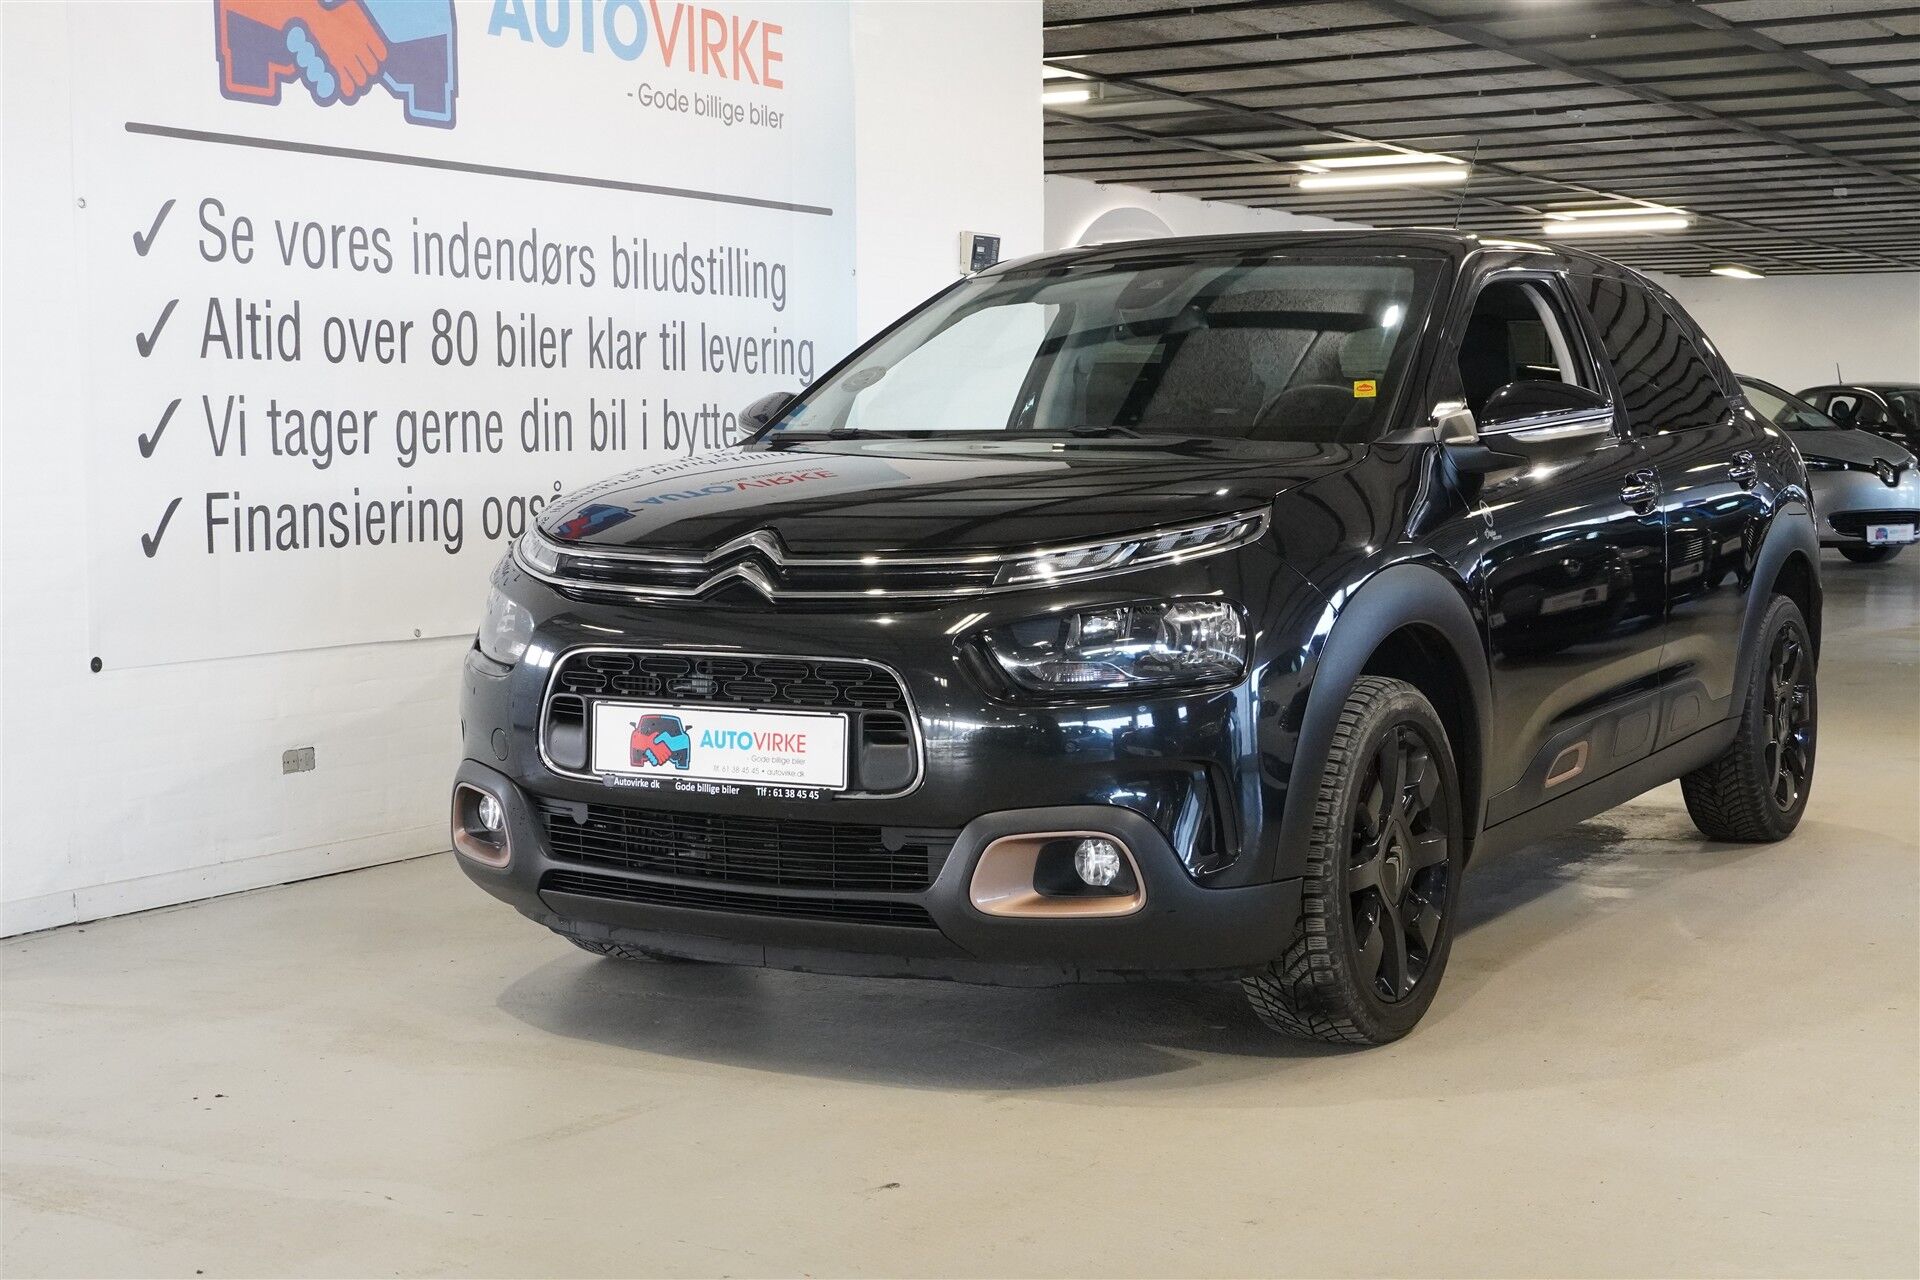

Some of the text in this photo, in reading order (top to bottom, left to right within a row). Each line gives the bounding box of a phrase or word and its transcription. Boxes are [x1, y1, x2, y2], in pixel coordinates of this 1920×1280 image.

[638, 83, 689, 113] Gode
[694, 92, 744, 126] billige
[749, 102, 784, 129] biler
[199, 197, 787, 312] Se vores indendørs biludstilling
[200, 297, 814, 387] Altid over 80 biler klar til levering
[202, 394, 738, 470] Vi tager gerne din bil i bytte
[206, 485, 463, 554] Finansiering
[700, 729, 806, 753] AUTOVIRKE
[751, 755, 769, 763] Gode
[675, 782, 740, 795] Gode billige biler
[756, 787, 767, 796] Tlf
[773, 788, 783, 798] 61
[784, 789, 795, 798] 38
[796, 790, 808, 799] 45
[809, 790, 820, 800] 45
